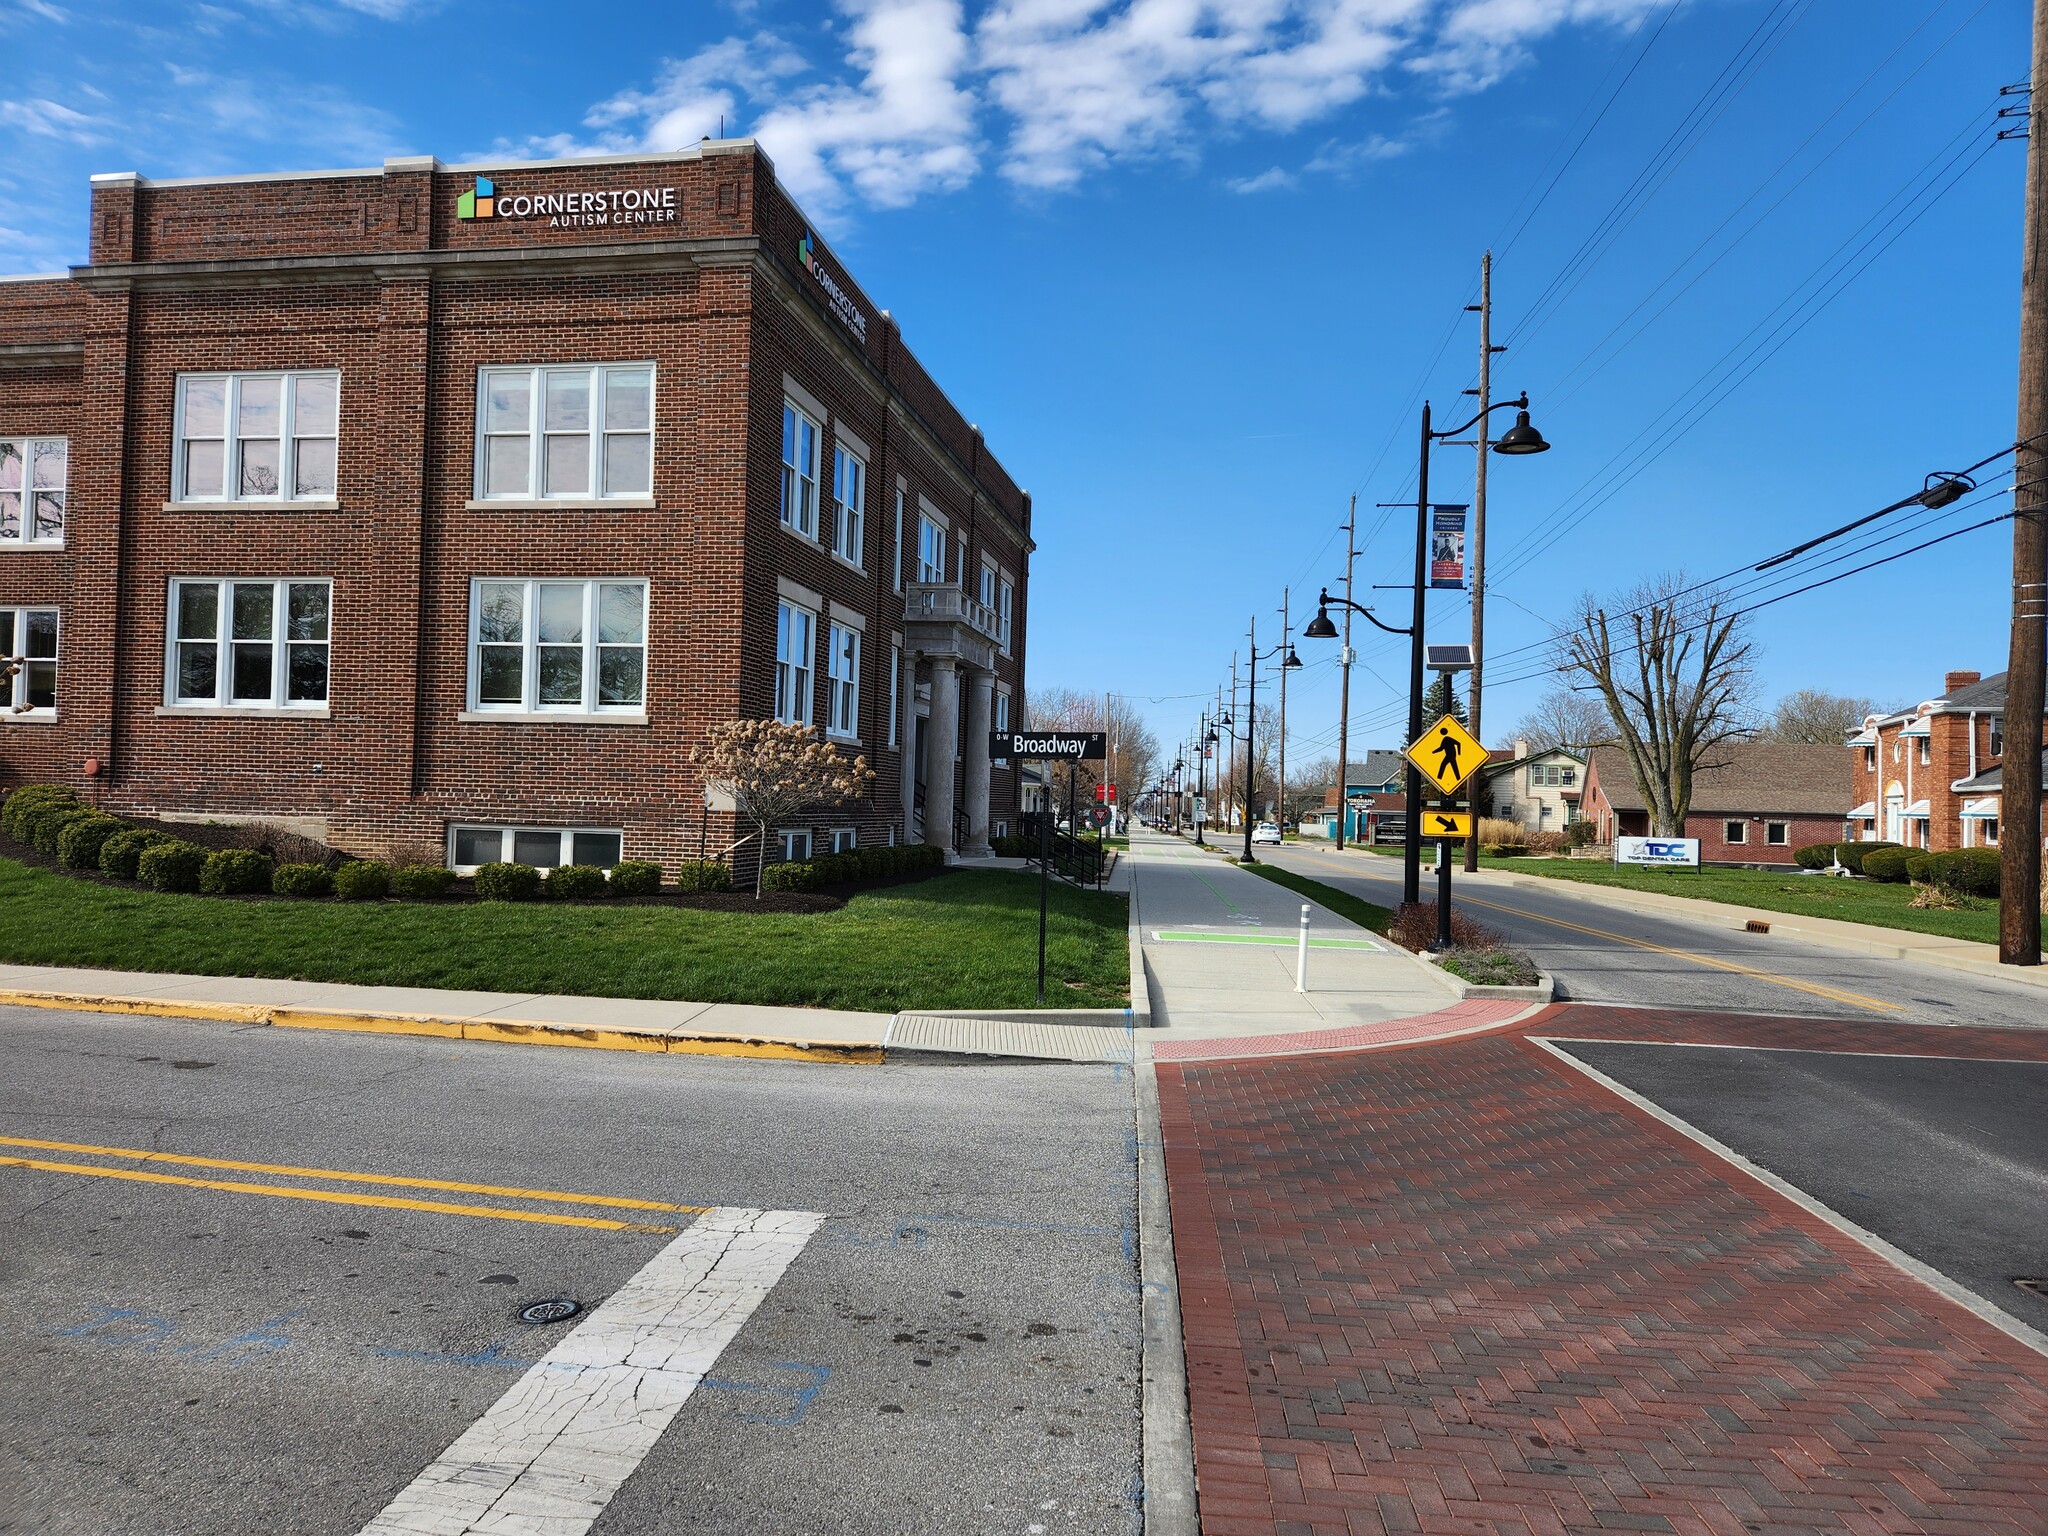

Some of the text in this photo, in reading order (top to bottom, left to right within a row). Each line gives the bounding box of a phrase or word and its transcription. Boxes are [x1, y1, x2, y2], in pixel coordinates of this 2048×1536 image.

[497, 187, 675, 217] CORNERSTONE
[549, 209, 675, 228] AUTISM CENTER
[812, 260, 866, 335] CORNERSTONE
[828, 299, 866, 345] AUTISM CENTER
[1014, 734, 1086, 758] Broadway
[1645, 843, 1686, 857] TDC
